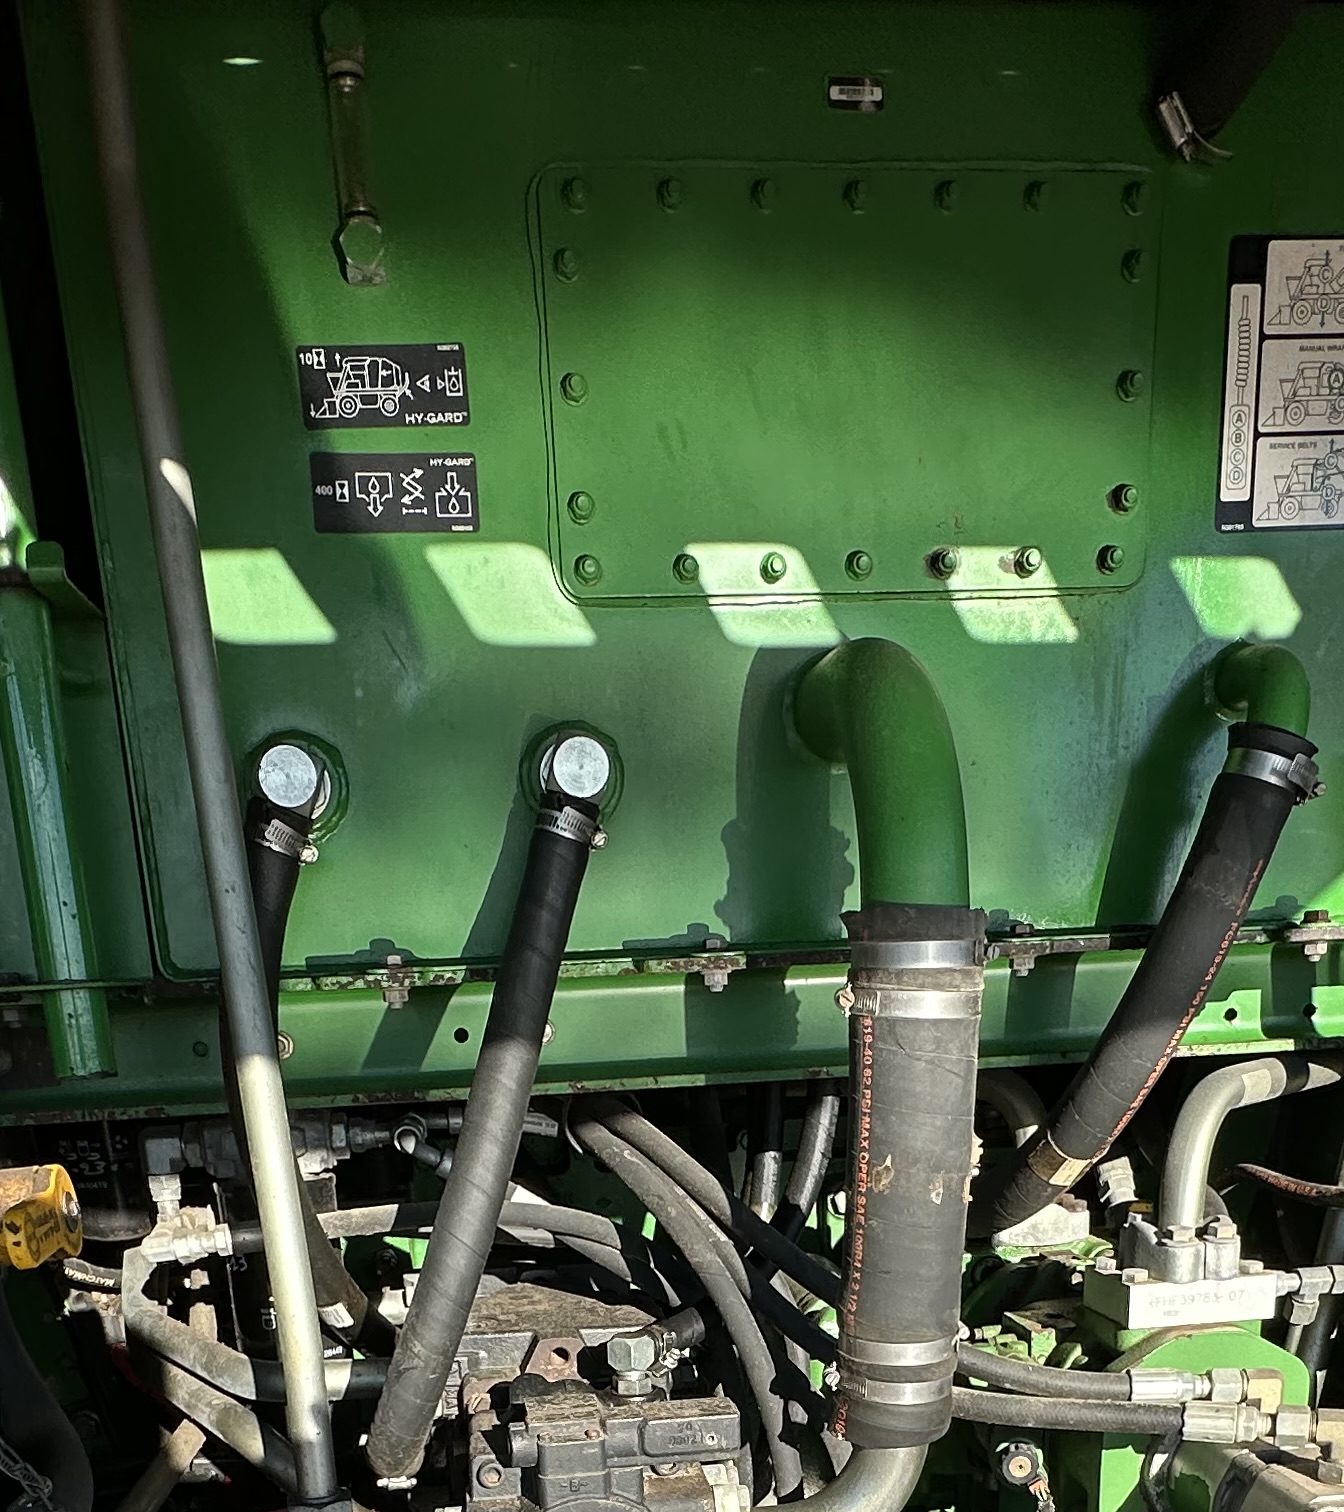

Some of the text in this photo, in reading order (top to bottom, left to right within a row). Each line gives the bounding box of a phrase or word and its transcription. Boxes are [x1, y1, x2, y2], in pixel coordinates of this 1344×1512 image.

[299, 353, 313, 365] 10
[315, 484, 334, 496] 400
[861, 1088, 873, 1113] PSI
[859, 1115, 871, 1149] MAX
[857, 1151, 870, 1194] OPER
[855, 1195, 867, 1226] SAE
